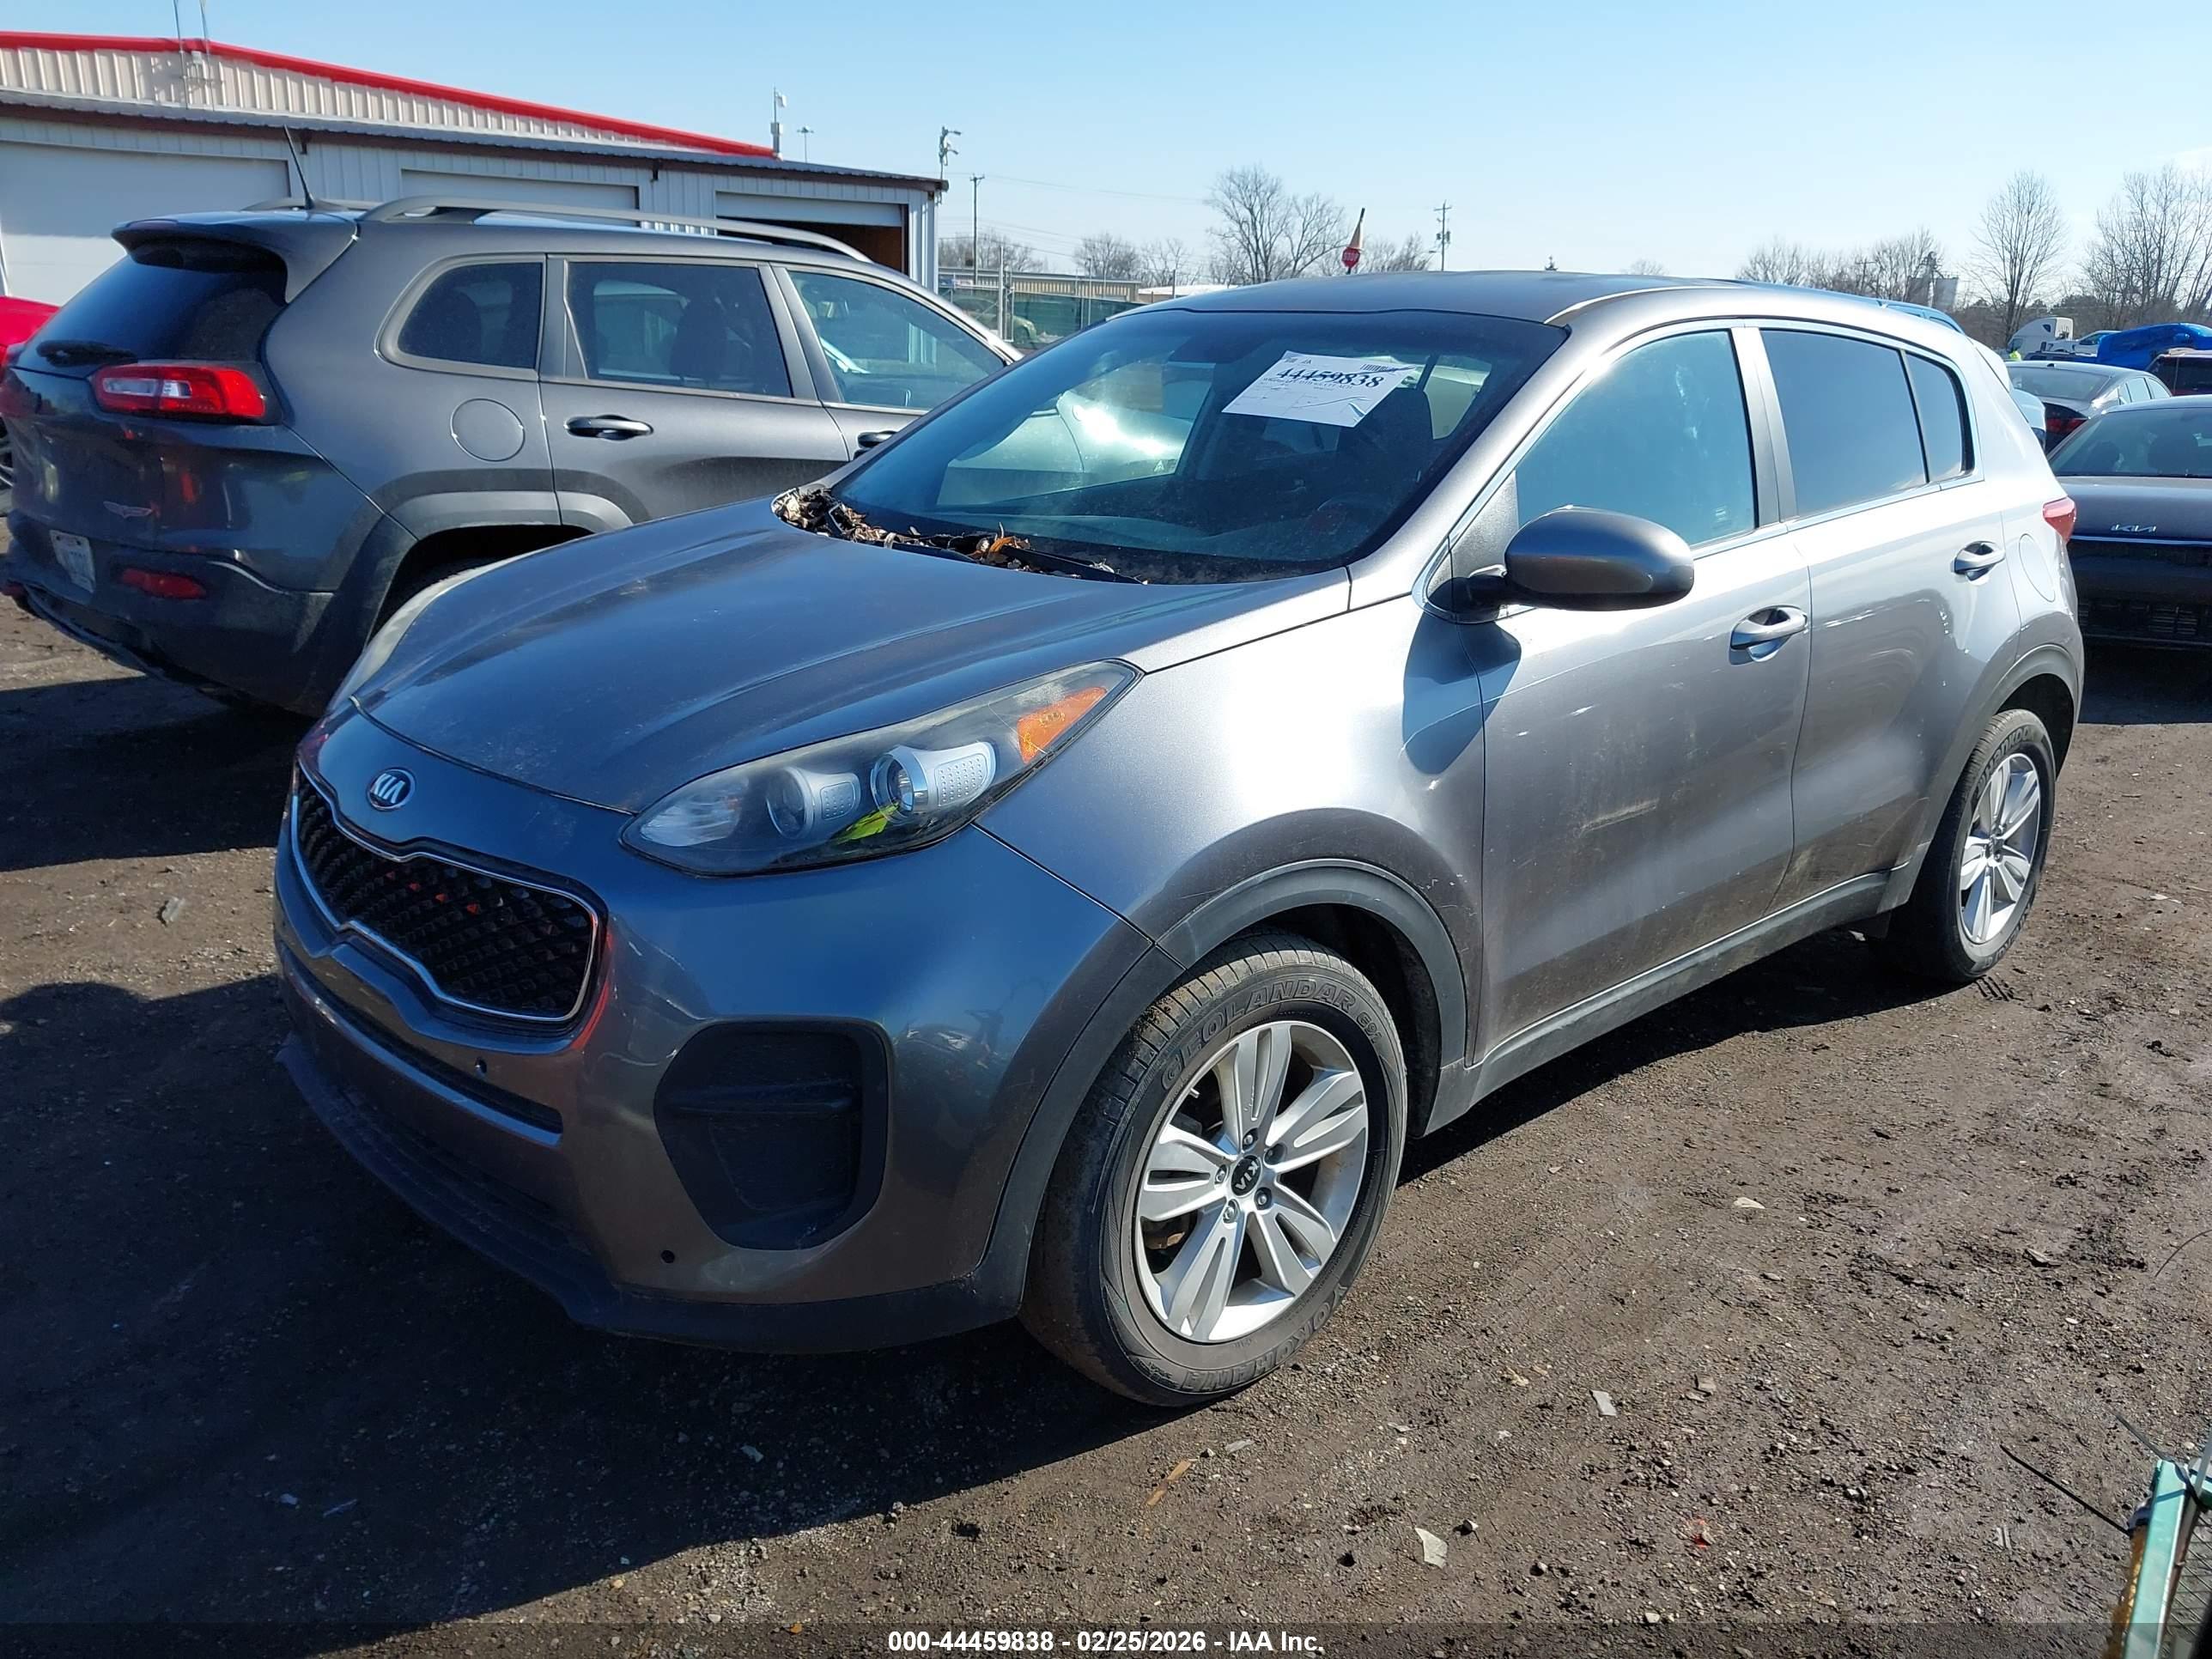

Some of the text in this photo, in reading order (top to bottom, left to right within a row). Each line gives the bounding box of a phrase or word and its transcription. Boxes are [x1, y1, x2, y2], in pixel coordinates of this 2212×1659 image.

[1276, 368, 1385, 388] 44459838
[370, 773, 406, 804] KIA
[1161, 978, 1357, 1090] GEOLANDAR
[1235, 1160, 1259, 1190] KIA
